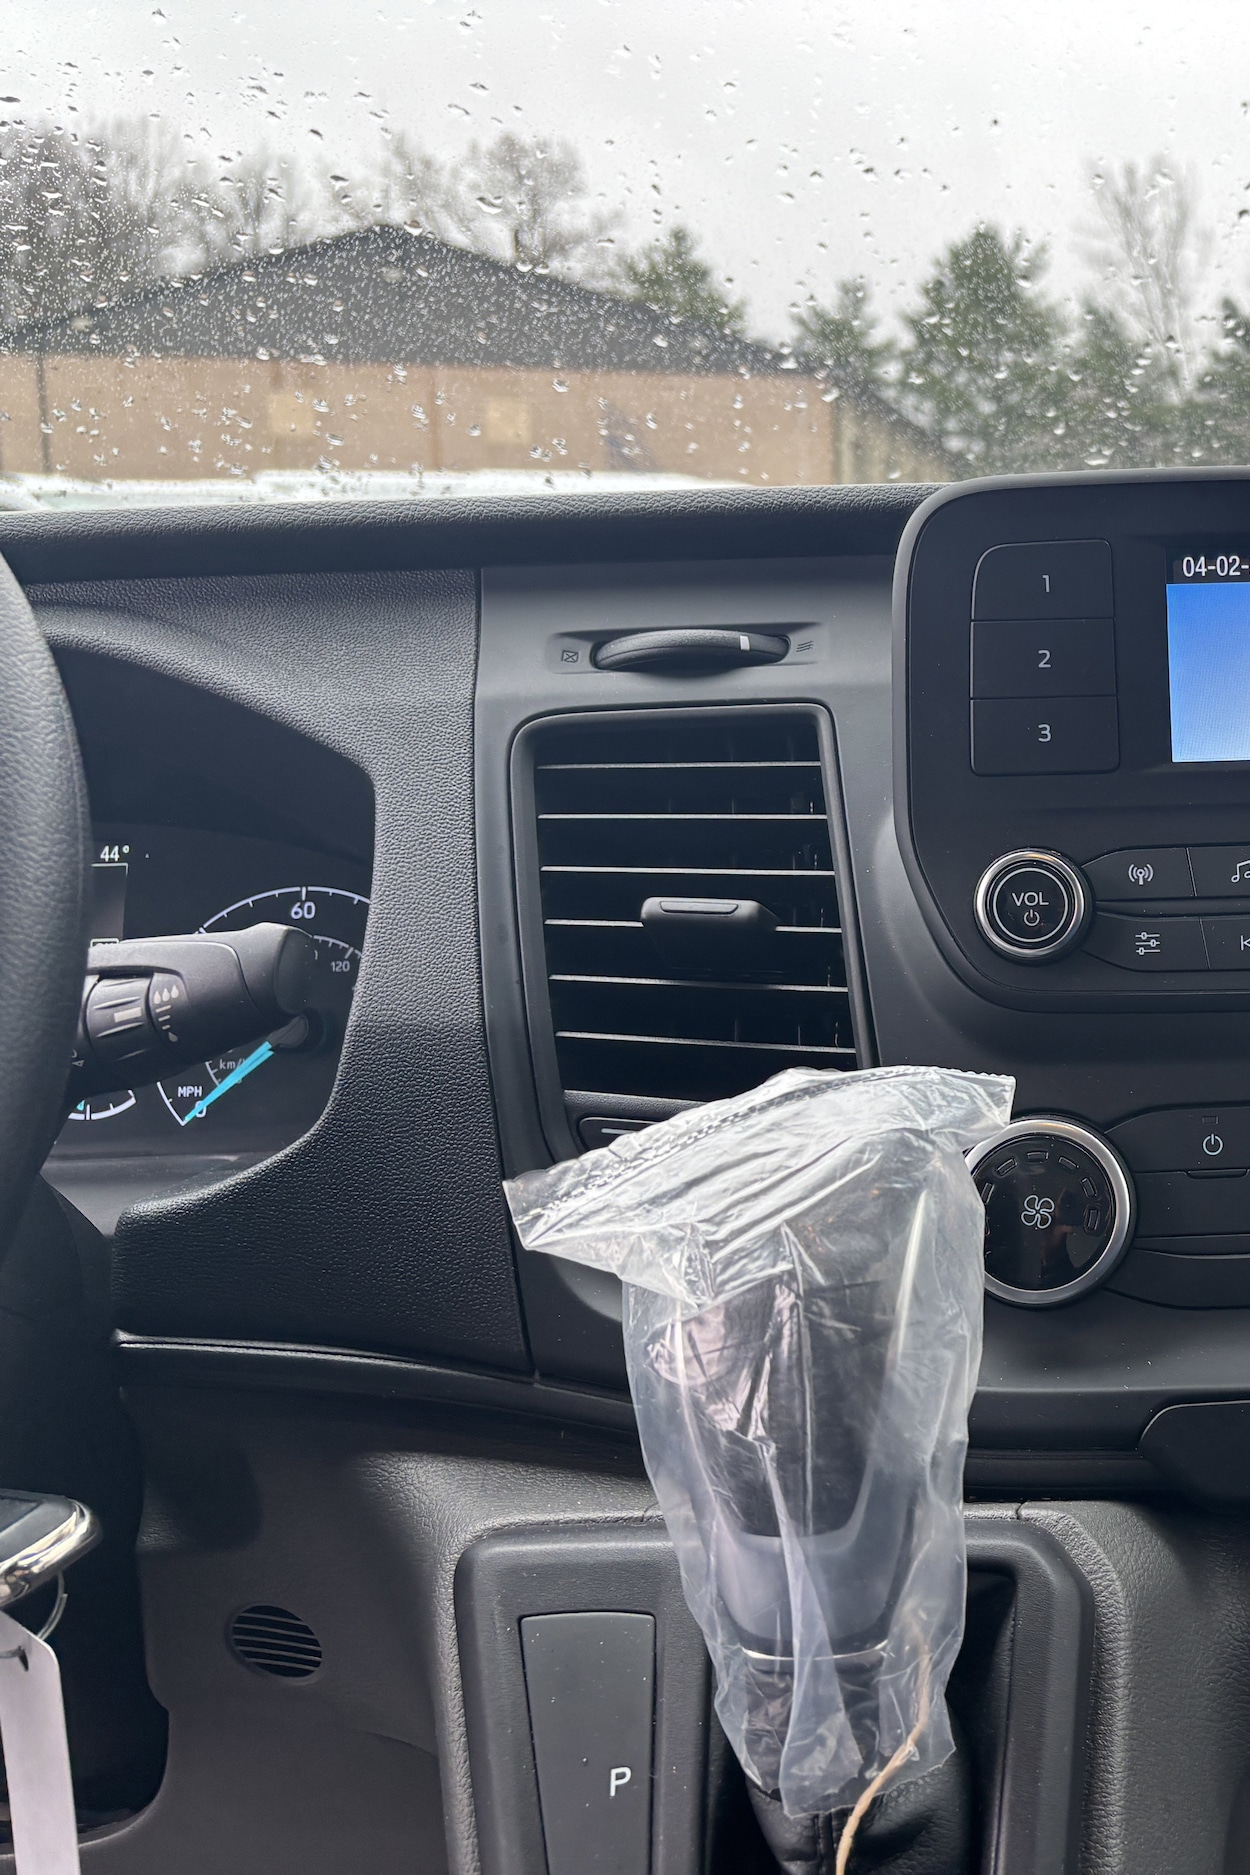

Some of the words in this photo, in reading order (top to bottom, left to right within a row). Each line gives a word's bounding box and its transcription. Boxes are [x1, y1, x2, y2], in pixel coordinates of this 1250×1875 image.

[1042, 574, 1051, 593] 1
[1037, 649, 1052, 669] 2
[1037, 723, 1052, 743] 3
[1011, 891, 1049, 907] VOL
[290, 901, 316, 920] 60
[330, 960, 351, 973] 120
[219, 1058, 248, 1071] km/
[177, 1085, 203, 1098] MPH
[609, 1766, 632, 1797] P
